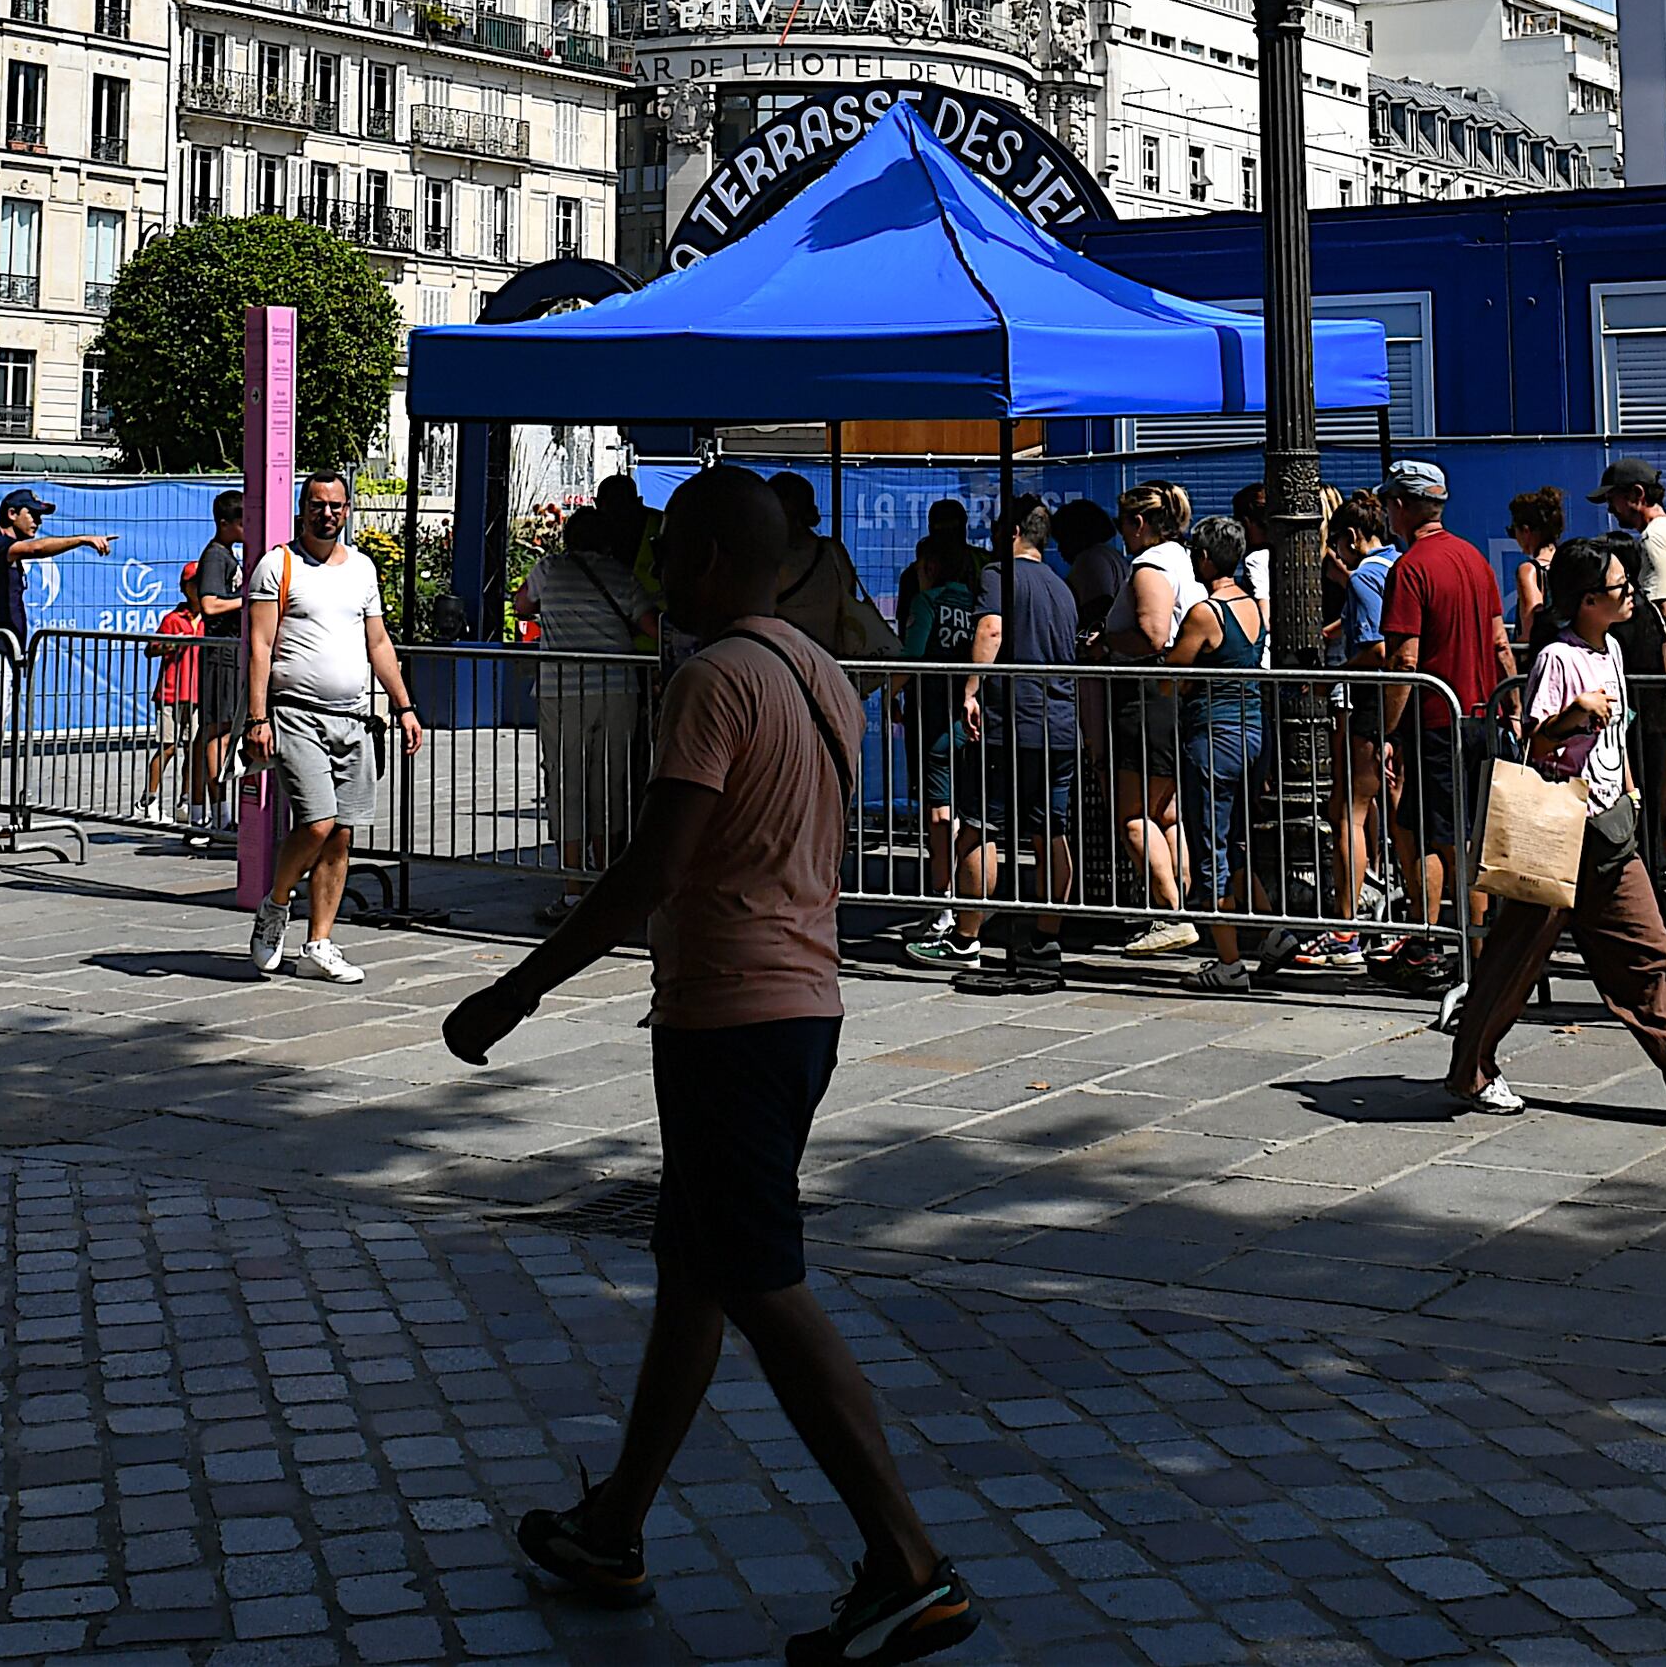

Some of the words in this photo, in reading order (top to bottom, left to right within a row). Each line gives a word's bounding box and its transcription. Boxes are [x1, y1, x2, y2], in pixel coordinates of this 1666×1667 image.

[618, 3, 659, 34] LE
[634, 56, 675, 82] AR
[690, 58, 724, 79] DE
[909, 62, 937, 83] DE
[951, 63, 1013, 98] VILLE
[934, 96, 1024, 176] DES
[1012, 155, 1086, 227] JE
[856, 492, 895, 529] LA
